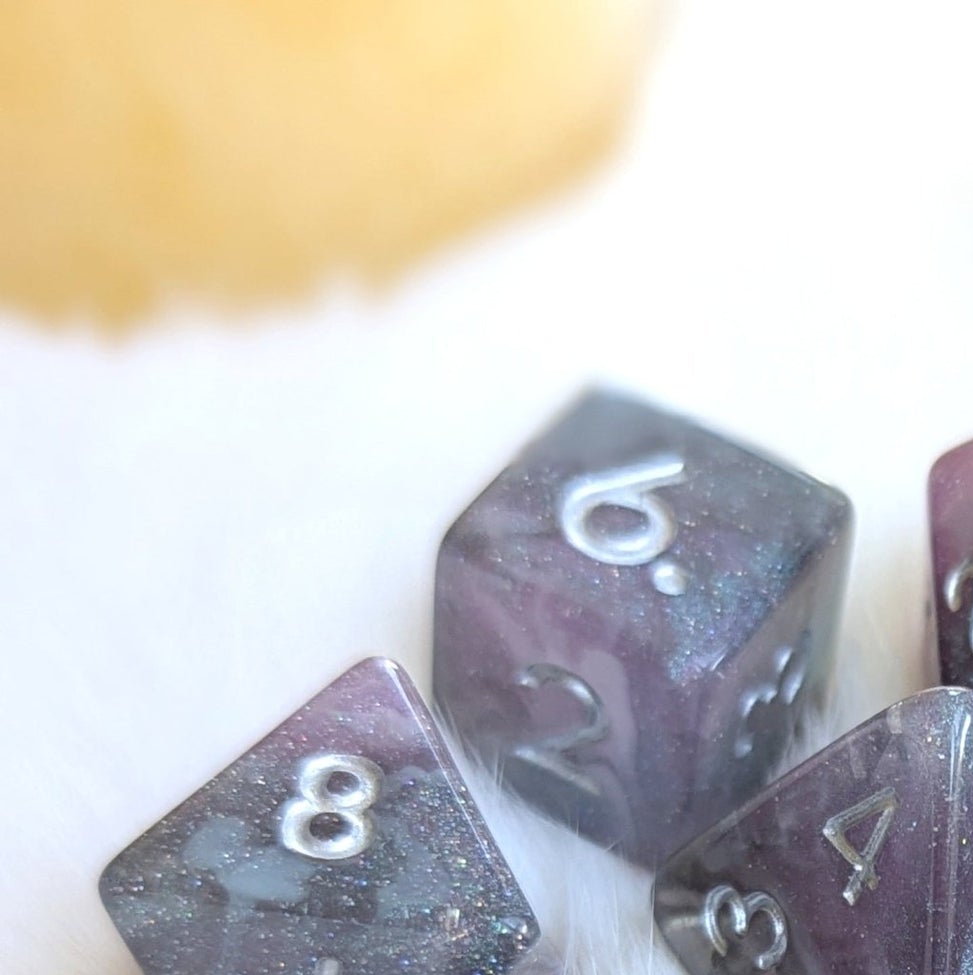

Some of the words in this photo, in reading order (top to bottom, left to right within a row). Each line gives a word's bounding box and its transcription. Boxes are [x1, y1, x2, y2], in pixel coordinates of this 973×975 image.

[514, 661, 612, 798] 2
[281, 753, 385, 860] 8
[822, 786, 897, 906] 4
[704, 884, 789, 971] 3
